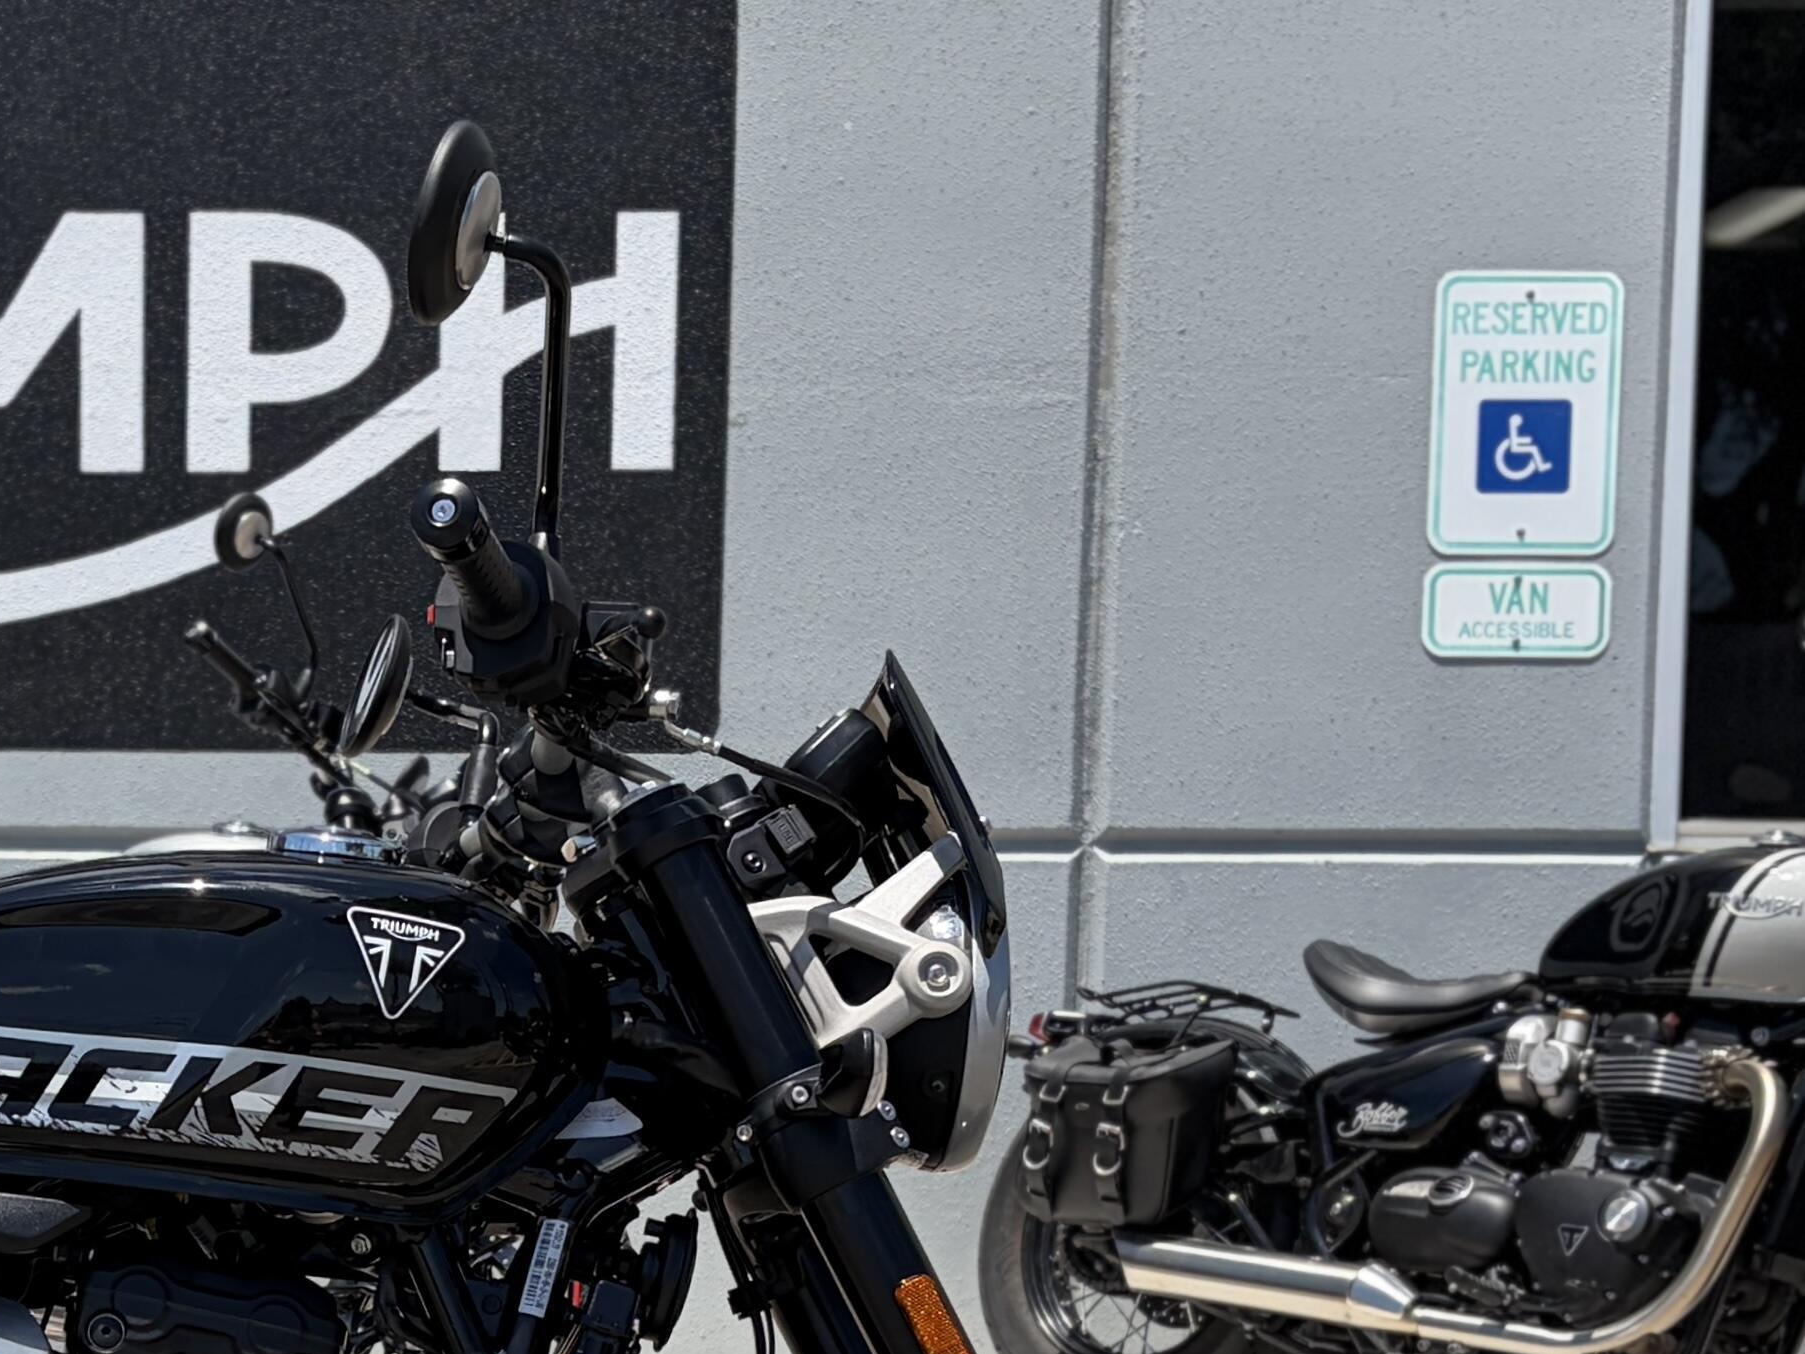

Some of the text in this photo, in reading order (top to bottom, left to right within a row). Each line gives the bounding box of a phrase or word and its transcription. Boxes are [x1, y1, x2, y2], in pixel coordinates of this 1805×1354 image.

[1452, 301, 1608, 335] RESERVED
[1460, 349, 1597, 384] PARKING
[1488, 582, 1549, 615] VAN
[1458, 621, 1576, 639] ACCESSIBLE
[370, 917, 440, 942] TRIUMPH
